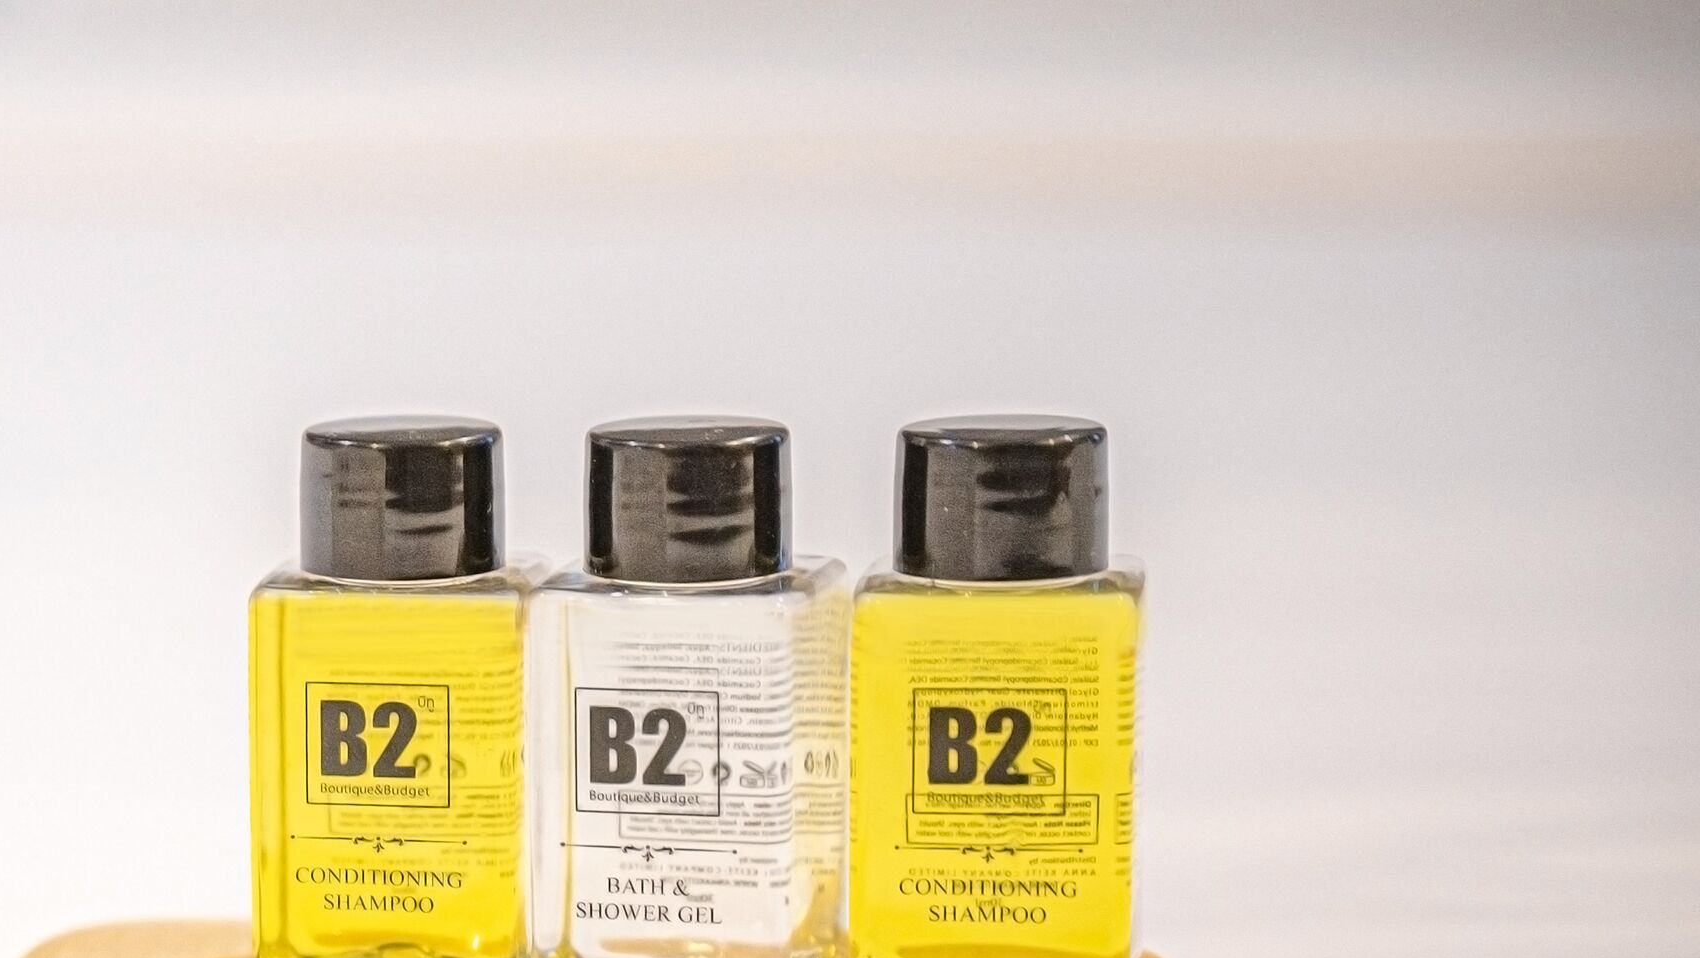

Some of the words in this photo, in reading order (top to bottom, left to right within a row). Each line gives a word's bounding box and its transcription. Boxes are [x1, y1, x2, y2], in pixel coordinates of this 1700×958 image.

[320, 700, 417, 778] B2
[589, 705, 687, 786] B2
[927, 706, 1032, 785] B2
[320, 783, 430, 798] Boutique&Budget
[589, 790, 700, 807] Boutique&Budget
[295, 867, 463, 889] CONDITIONING
[607, 877, 665, 896] BATH
[673, 879, 690, 897] &
[899, 877, 1078, 898] CONDITIONING
[323, 894, 435, 914] SHAMPOO
[576, 902, 670, 922] SHOWER
[678, 905, 722, 924] GEL
[928, 905, 1047, 924] SHAMPOO
